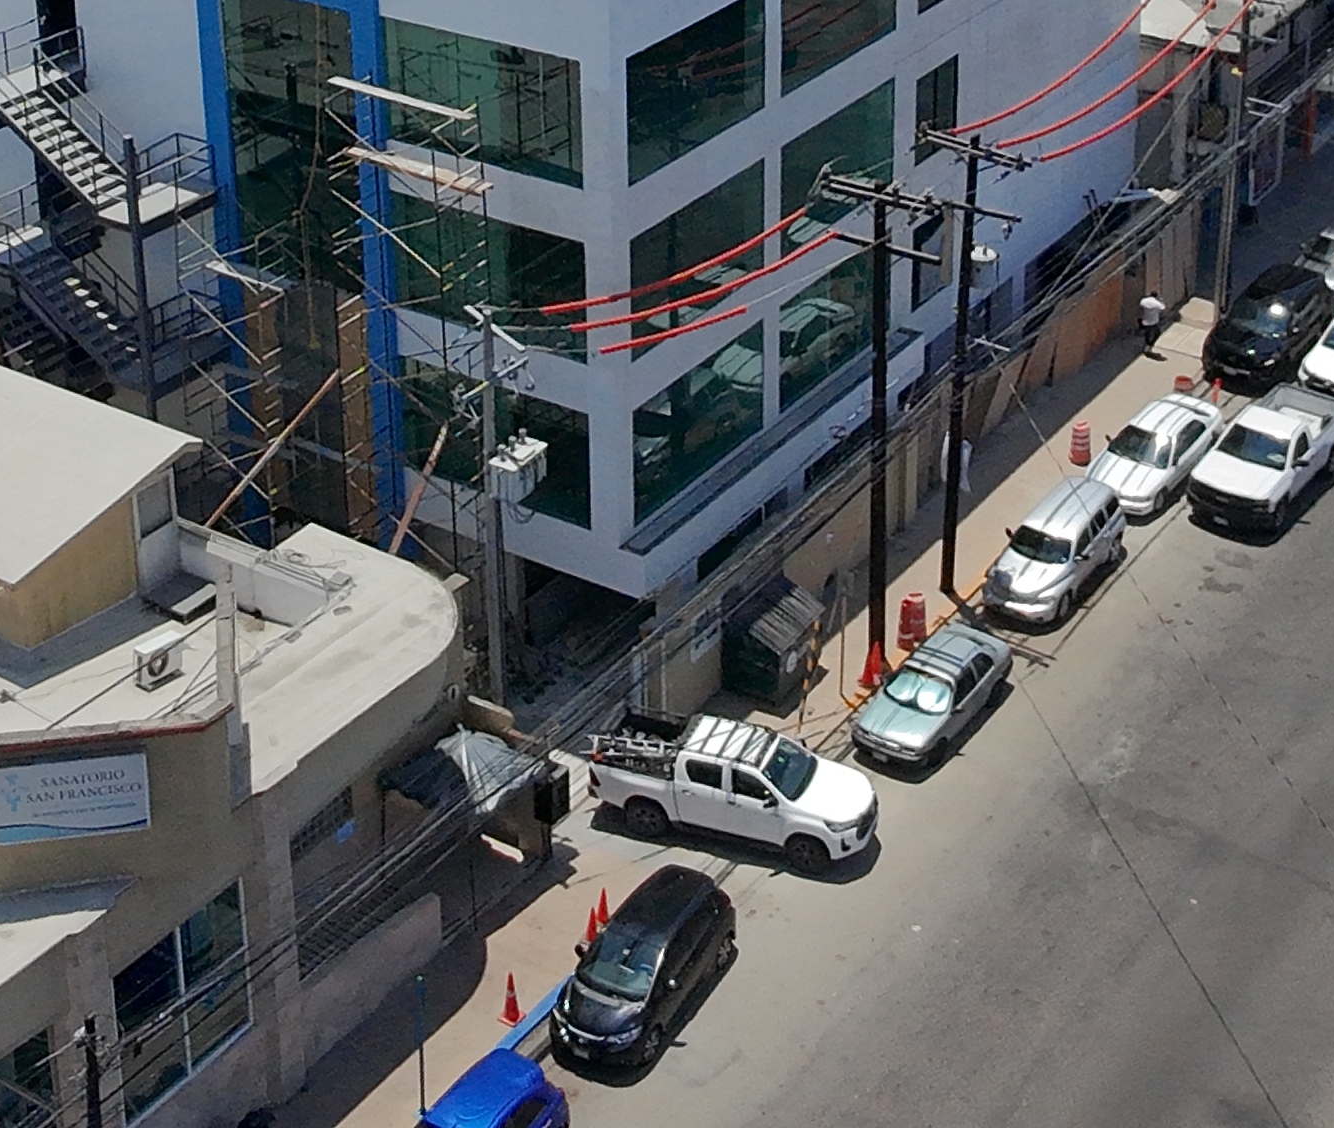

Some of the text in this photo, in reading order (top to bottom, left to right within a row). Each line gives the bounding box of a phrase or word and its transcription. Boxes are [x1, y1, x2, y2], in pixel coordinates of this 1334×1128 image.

[39, 769, 126, 789] SANATORIO
[26, 781, 143, 804] SAN FRANCISCO
